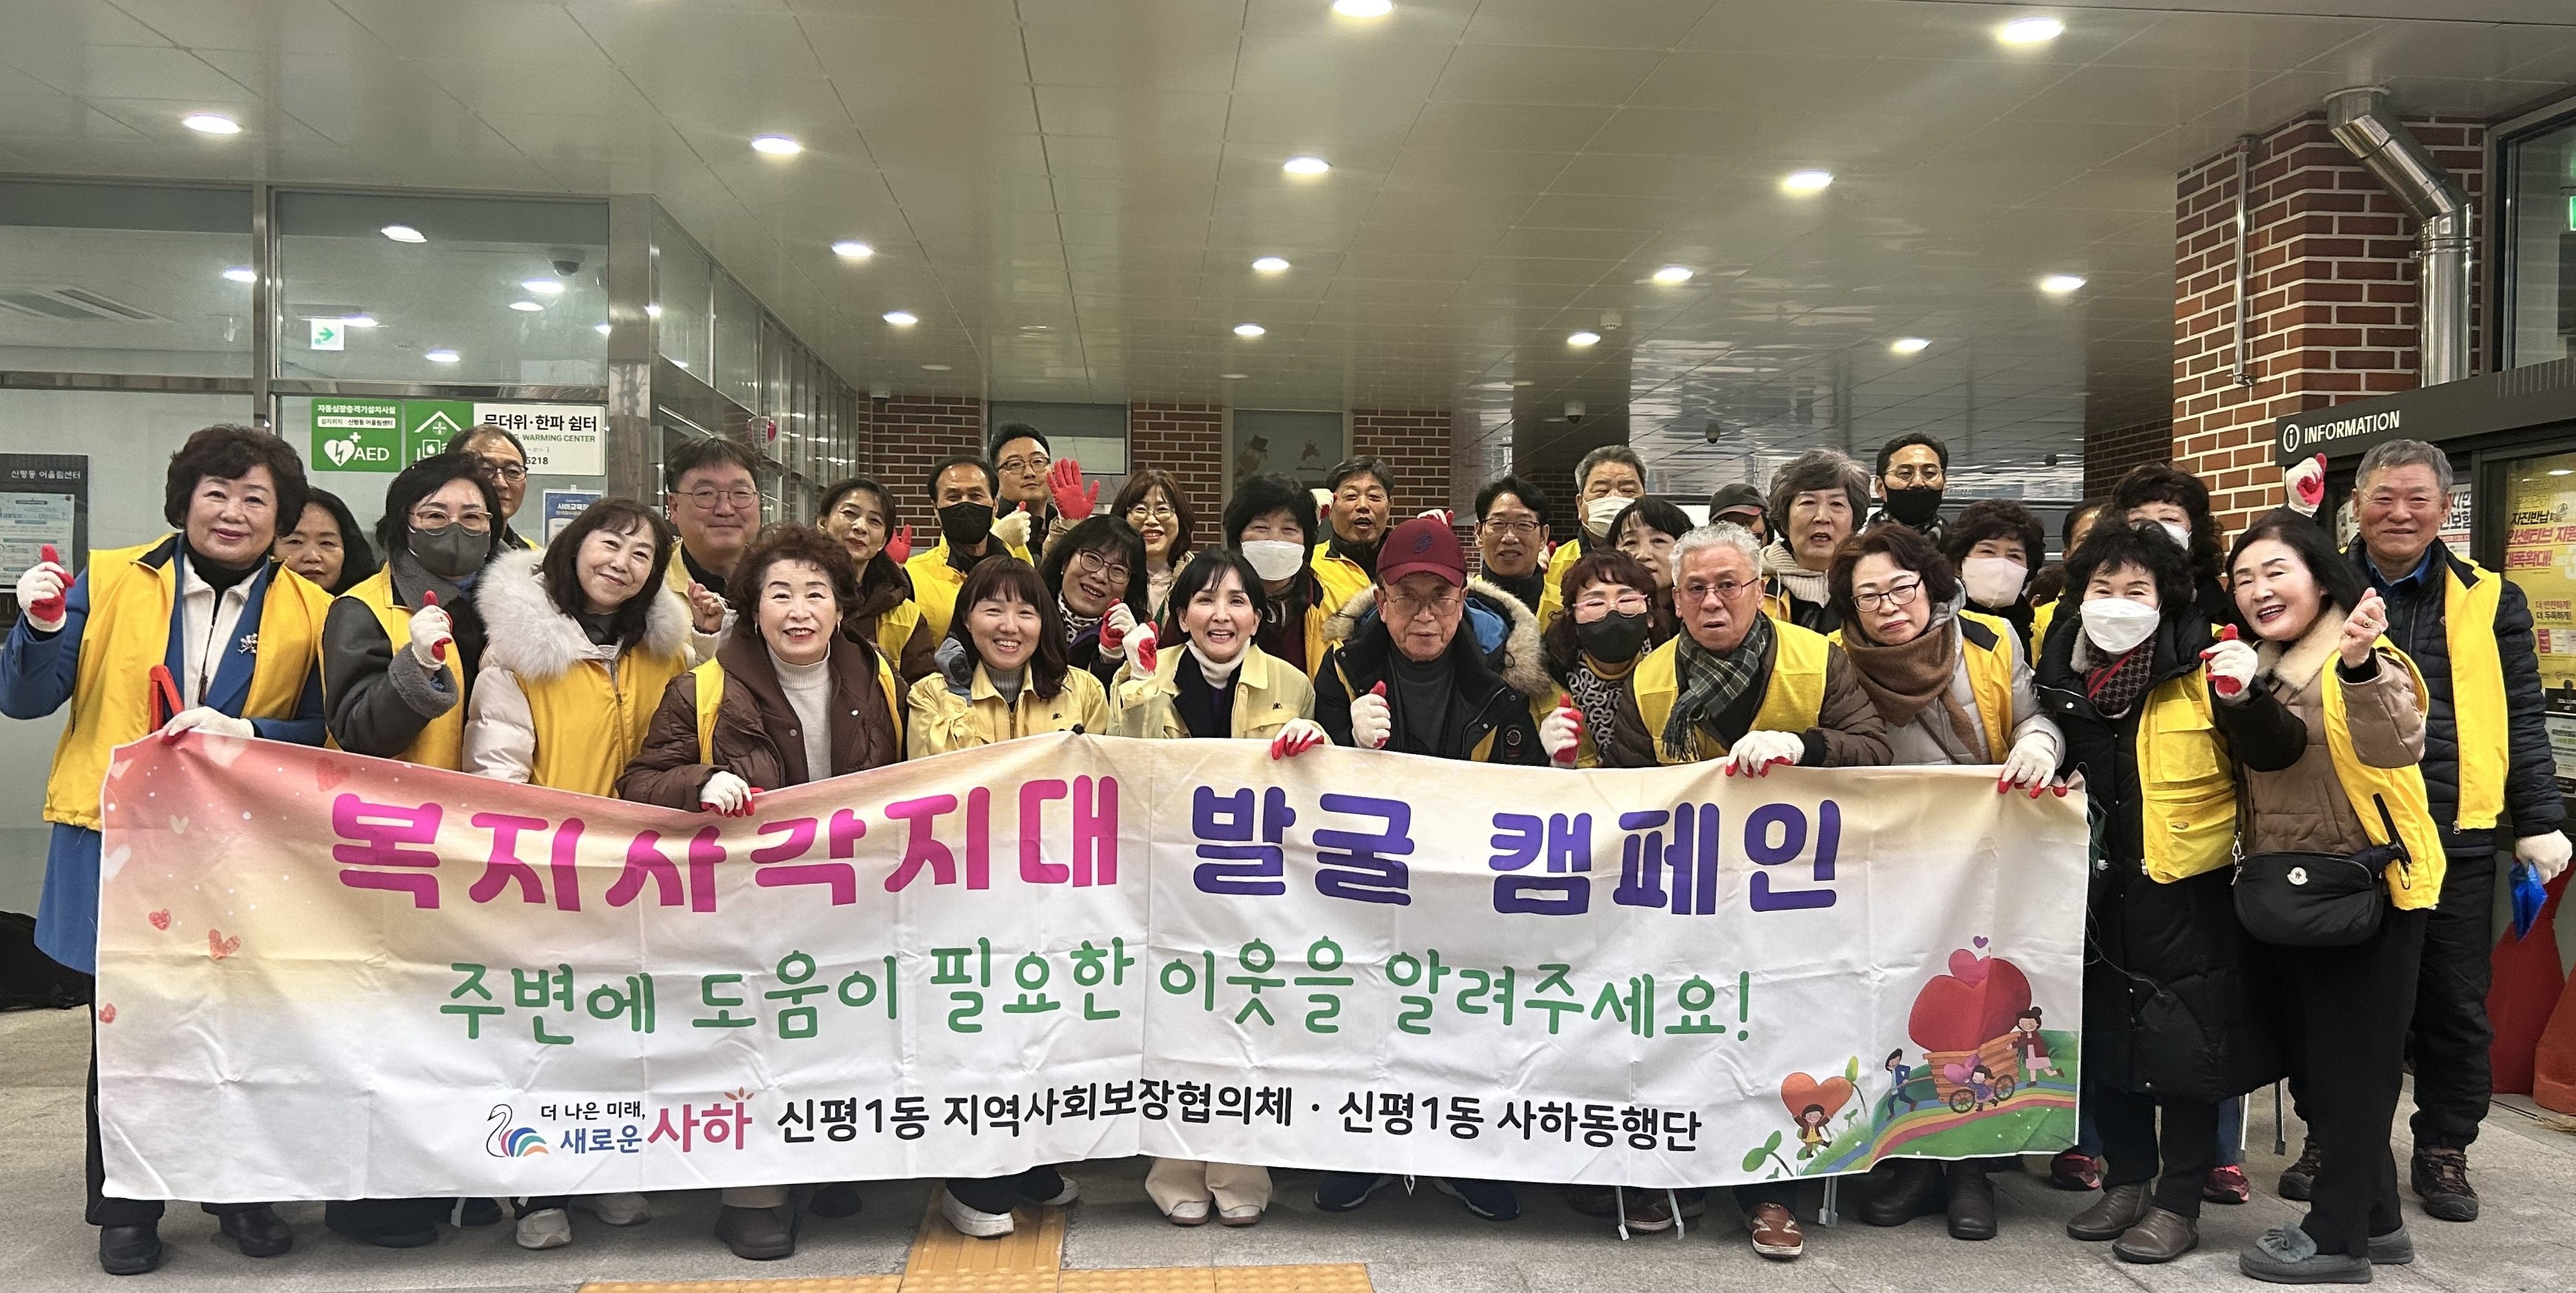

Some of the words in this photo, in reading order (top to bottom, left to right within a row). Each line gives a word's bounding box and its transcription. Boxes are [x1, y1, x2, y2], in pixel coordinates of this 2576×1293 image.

[317, 405, 396, 415] 자동심장충격기설치시설
[568, 415, 597, 432] 쉼터
[2304, 410, 2400, 445] INFORMATION
[353, 447, 390, 462] AED
[11, 470, 37, 479] 신평동
[39, 470, 81, 480] 어울림센터
[2510, 510, 2550, 526] 자진반납
[2506, 528, 2554, 545] 인센티브
[2535, 600, 2542, 610] 더
[2536, 611, 2543, 620] 더
[332, 774, 1119, 913] 복지사각지대
[1192, 786, 1415, 906] 발굴
[1489, 799, 1841, 916] 캠페인
[440, 962, 655, 1045] 주변에
[692, 950, 898, 1039] 도움이
[930, 936, 1135, 1033] 필요한
[1160, 936, 1354, 1033] 이웃을
[1384, 948, 1750, 1042] 알려주세요!
[540, 1103, 558, 1121] 더
[565, 1101, 600, 1121] 나은
[606, 1100, 646, 1120] 미래,
[777, 1095, 930, 1145] 신평1동
[943, 1077, 1293, 1139] 지역사회보장협의체
[1338, 1089, 1485, 1140] 신평1동
[1497, 1099, 1703, 1153] 사하동행단
[560, 1125, 643, 1155] 새로운
[647, 1095, 753, 1153] 사하
